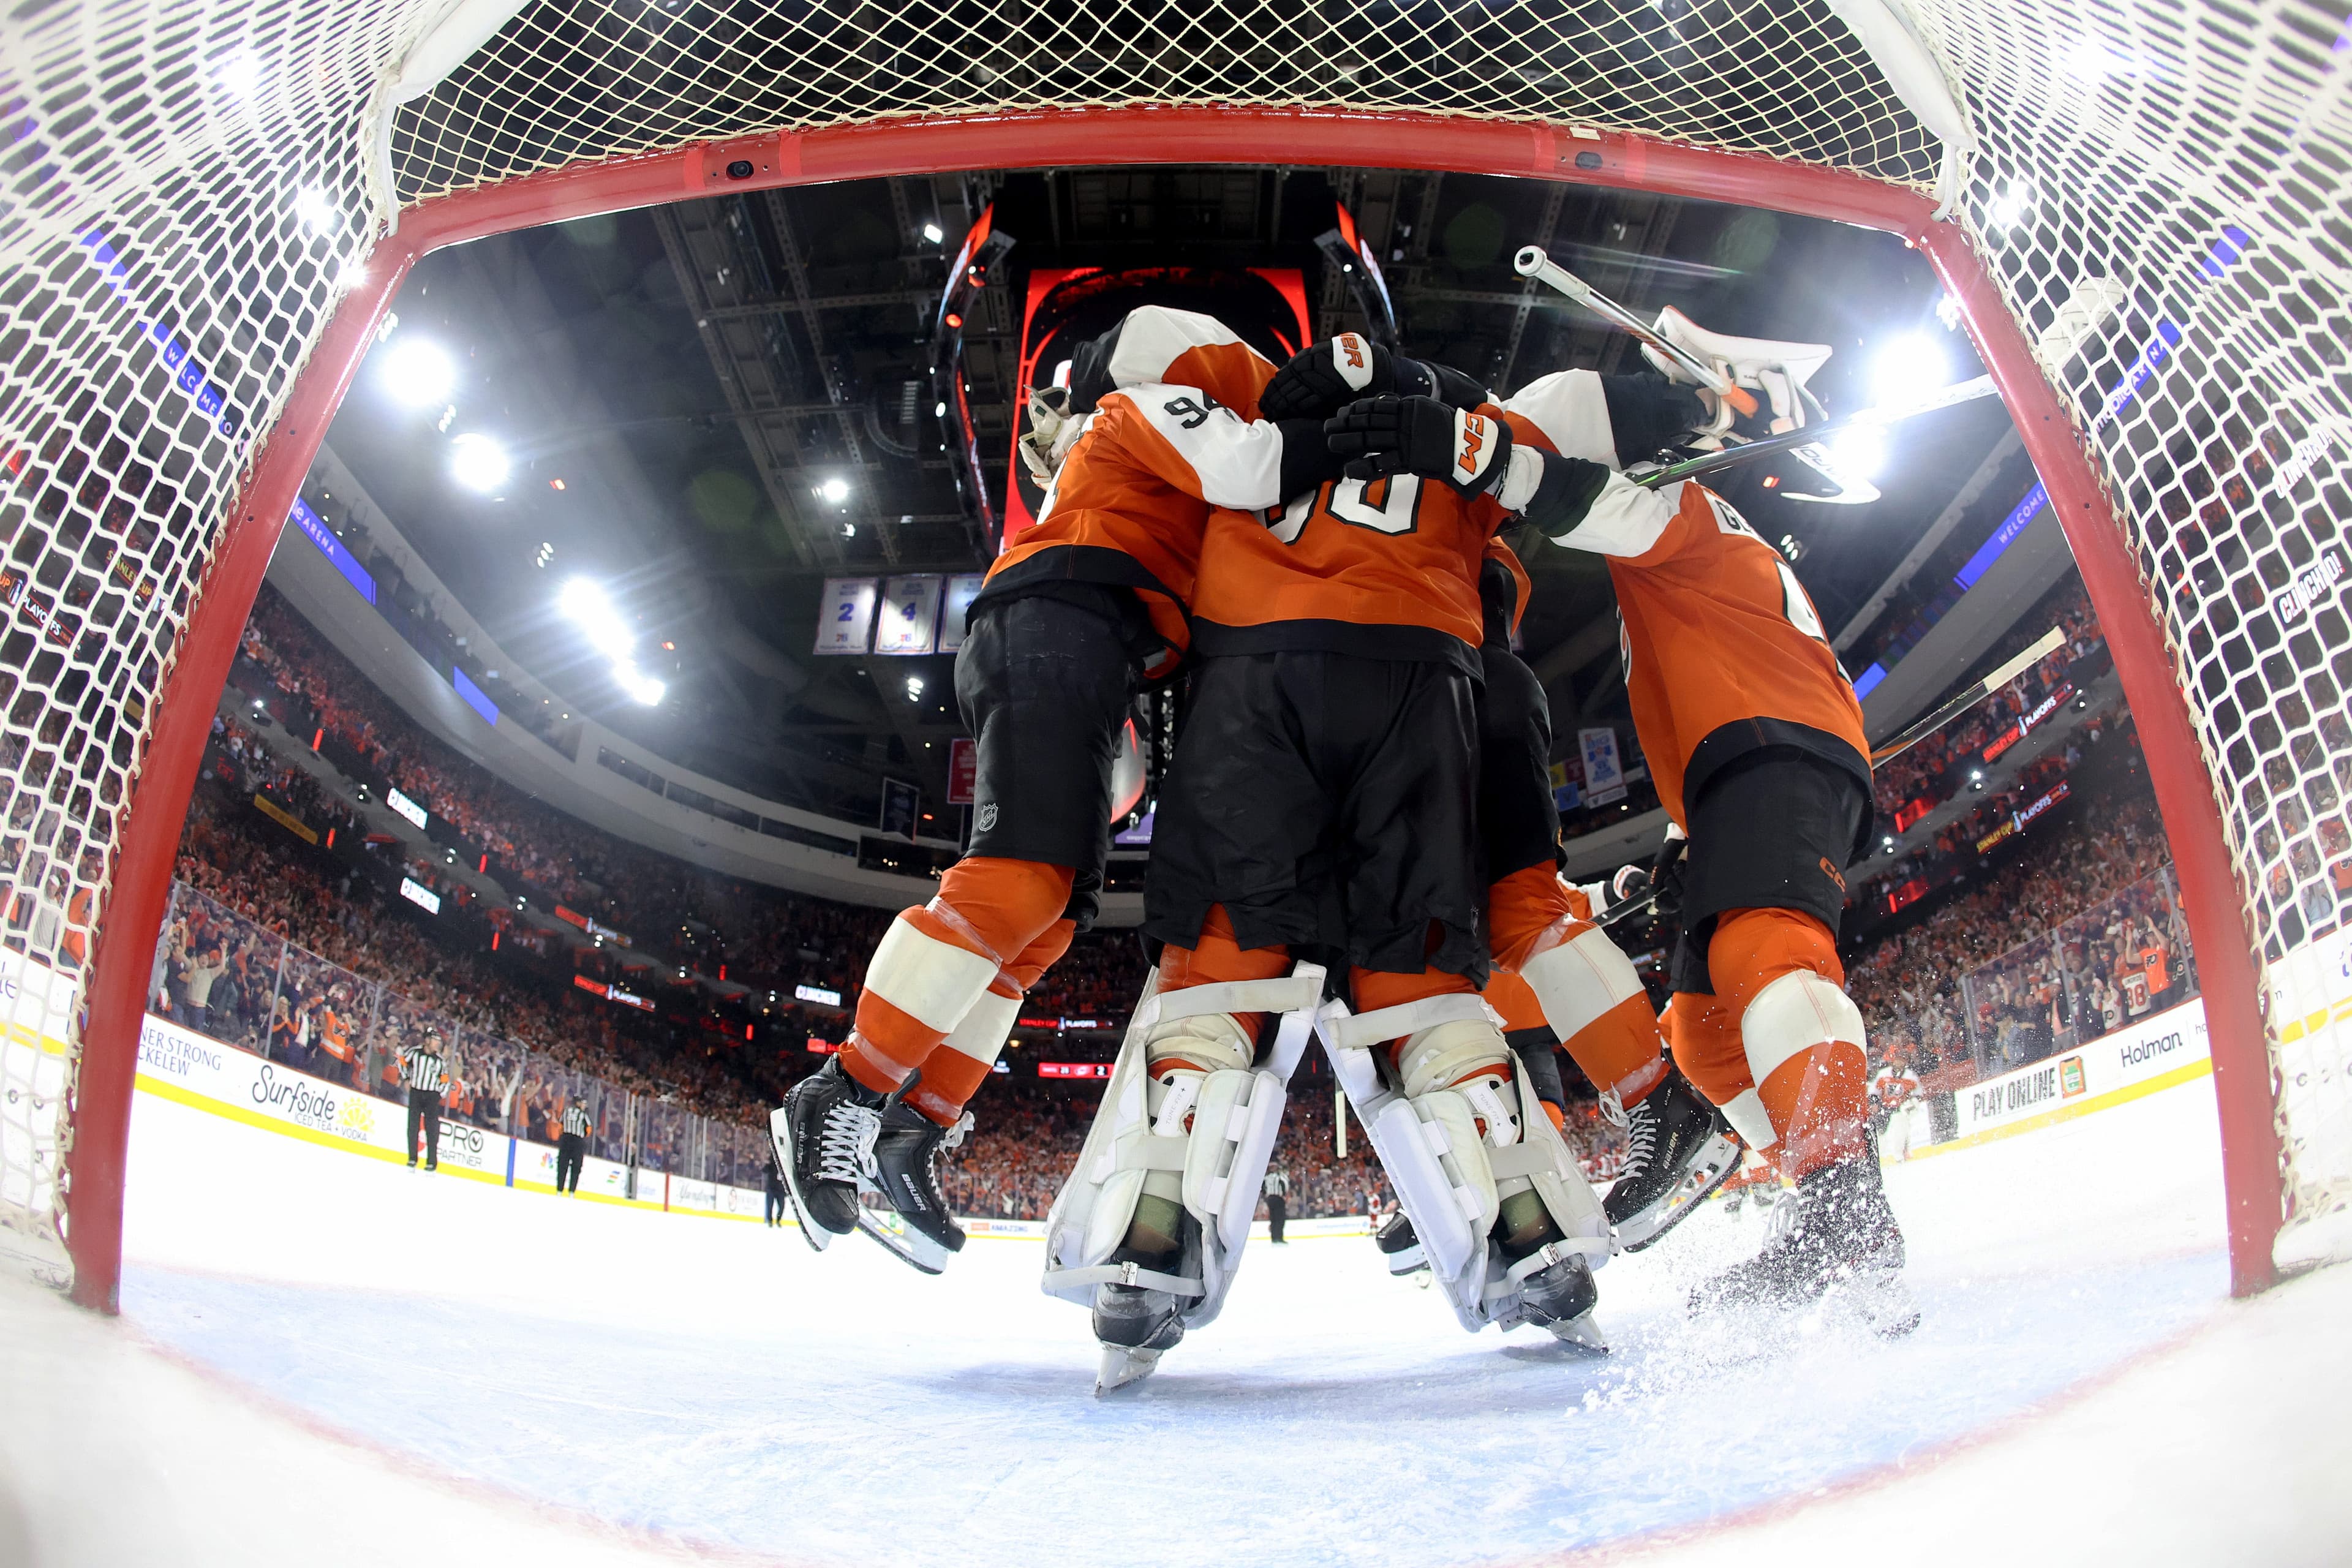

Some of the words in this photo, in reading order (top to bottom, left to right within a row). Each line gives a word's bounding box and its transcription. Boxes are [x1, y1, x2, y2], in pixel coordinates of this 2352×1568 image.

[1997, 489, 2045, 545] WELCOME
[301, 516, 334, 557] ARENA
[837, 603, 854, 622] 2
[902, 602, 917, 621] 4
[2025, 695, 2057, 727] PLAYOFFS
[1066, 1019, 1098, 1028] PLAYOFFS
[167, 1036, 222, 1071] STRONG
[2120, 1031, 2183, 1068] Holman
[252, 1065, 335, 1120] Surfside
[1973, 1085, 2003, 1121] PLAY
[2007, 1067, 2056, 1110] ONLINE
[294, 1112, 314, 1127] ICED
[316, 1118, 333, 1133] TEA
[341, 1126, 368, 1142] VODKA
[437, 1147, 482, 1167] PARTNER
